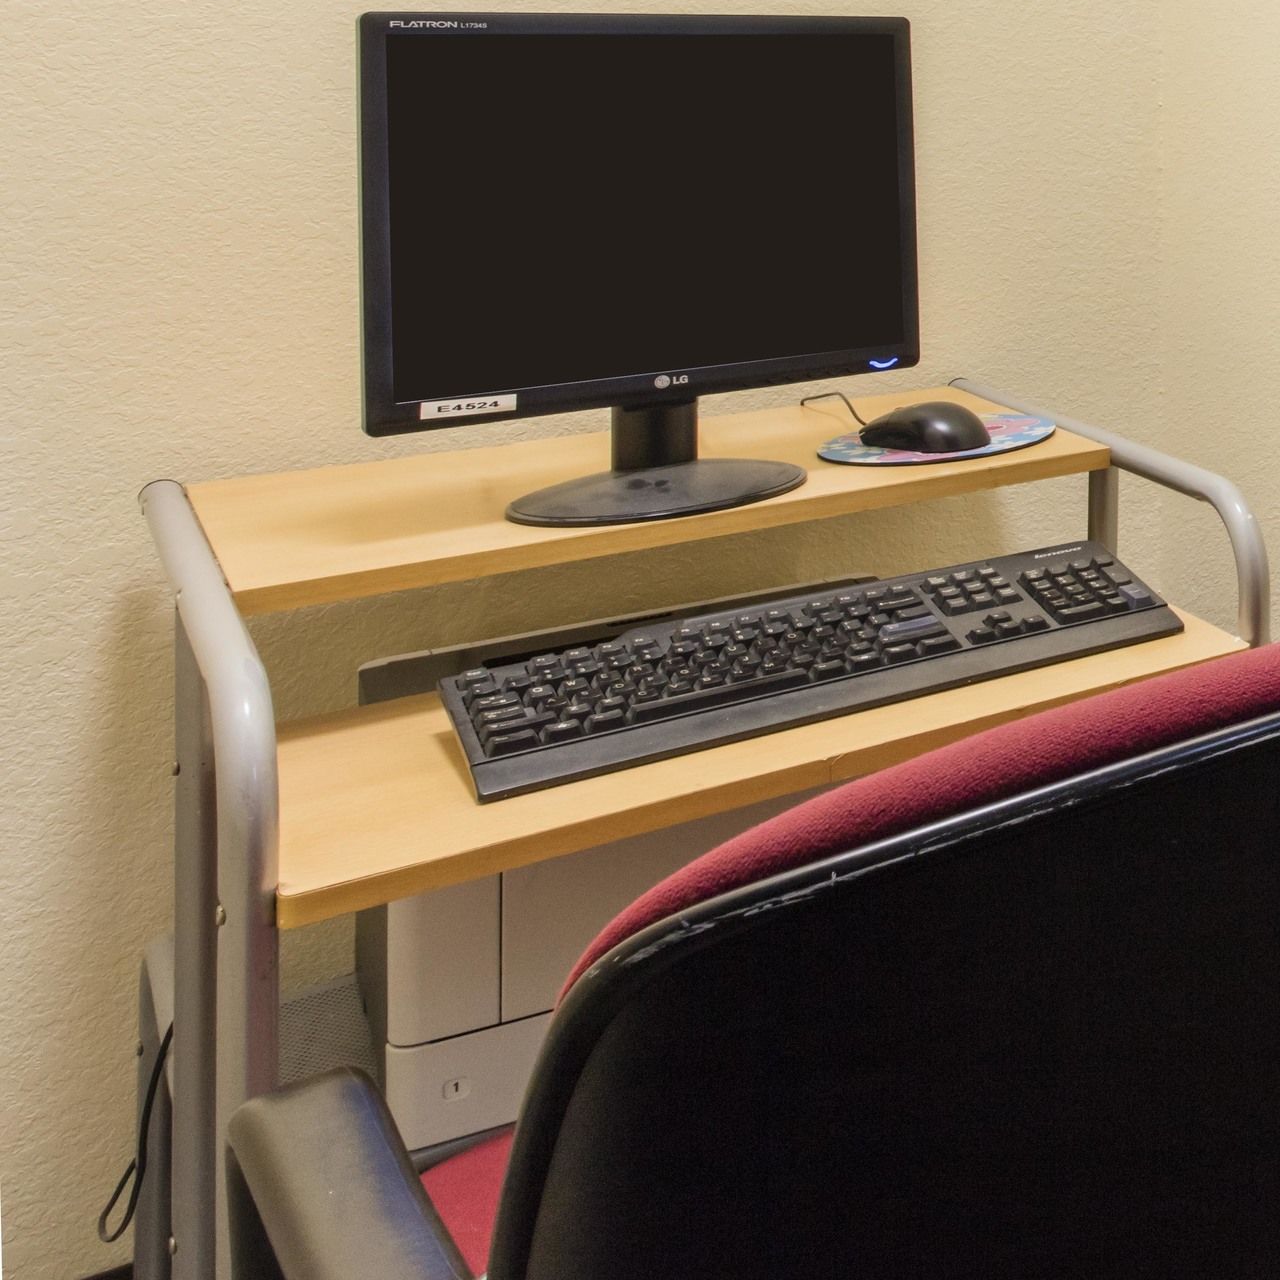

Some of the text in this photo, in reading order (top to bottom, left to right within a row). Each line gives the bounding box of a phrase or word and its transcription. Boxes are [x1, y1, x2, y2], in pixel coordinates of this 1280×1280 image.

[389, 20, 458, 29] FLATRON
[672, 374, 690, 386] LG
[436, 400, 500, 413] E4524
[453, 1081, 459, 1092] 1
